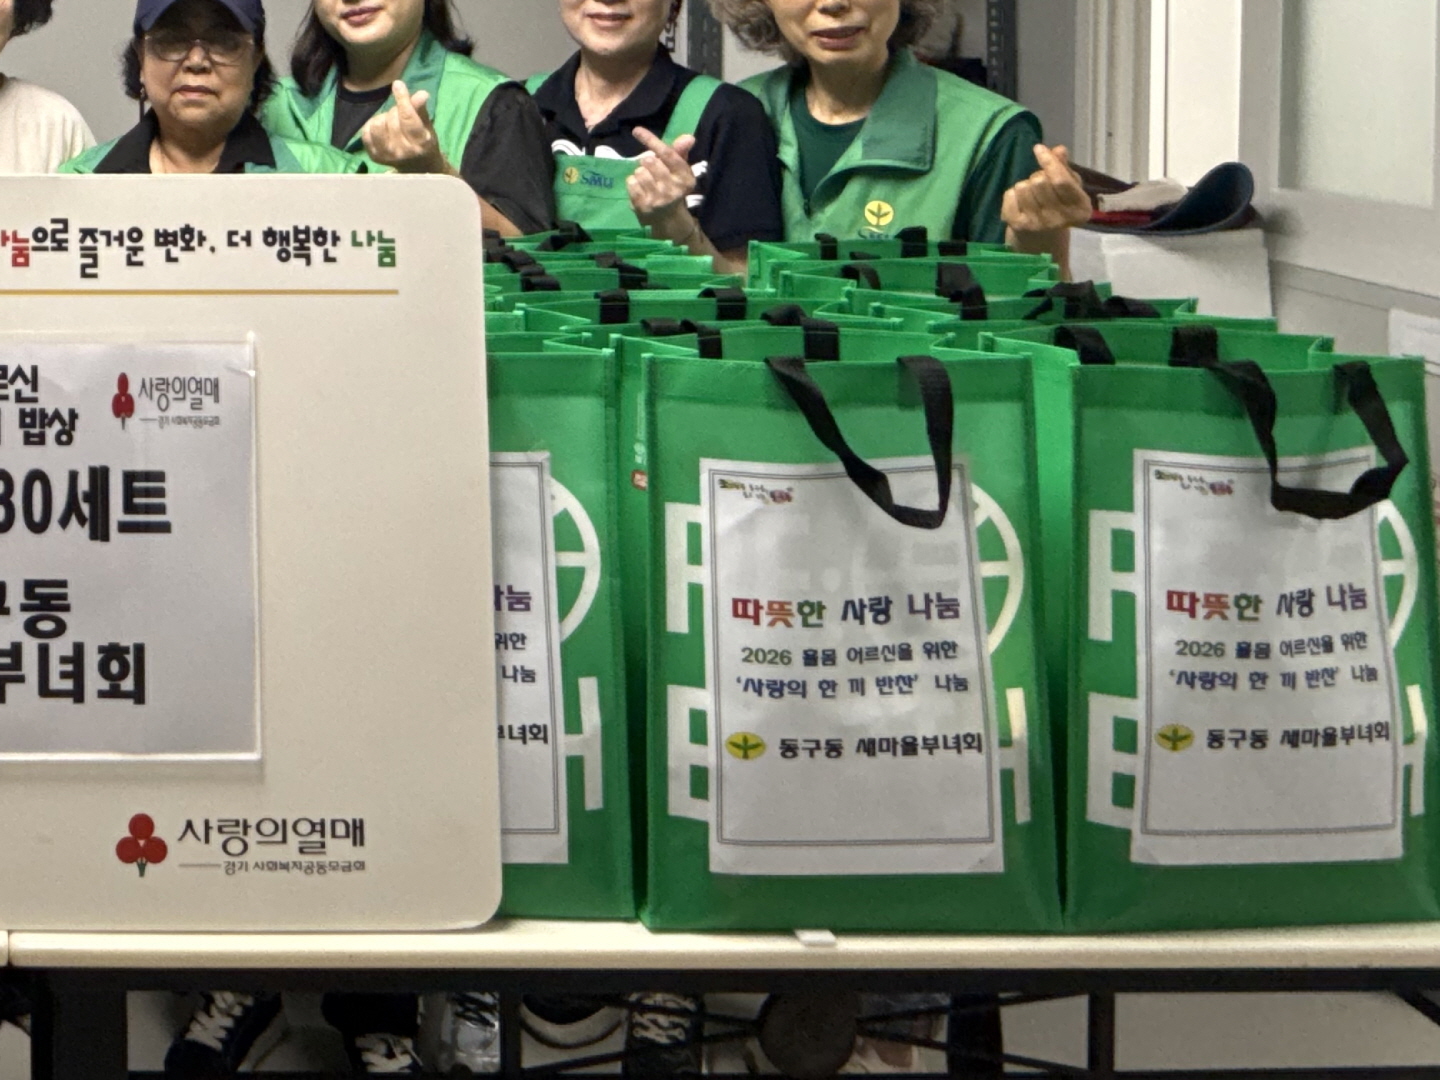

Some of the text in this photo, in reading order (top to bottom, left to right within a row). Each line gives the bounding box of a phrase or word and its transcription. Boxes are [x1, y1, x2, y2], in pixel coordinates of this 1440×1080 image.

[79, 227, 144, 279] 즐거운
[154, 224, 215, 263] 변화,
[227, 230, 251, 247] 더
[262, 225, 341, 266] 행복한
[351, 230, 396, 267] 나눔
[138, 377, 219, 412] 사랑의열매
[19, 408, 79, 446] 밥상
[732, 592, 960, 628] 따뜻한 사랑 나눔
[1167, 583, 1367, 623] 따뜻한 사랑 나눔
[742, 647, 792, 666] 2026
[847, 643, 913, 663] 어르신을
[1176, 640, 1227, 658] 2026
[1280, 635, 1334, 658] 어르신을
[500, 664, 536, 683] 나눔
[935, 674, 969, 692] 나눔
[1352, 665, 1378, 682] 나눔
[779, 733, 982, 759] 동구동 새마을부녀회
[1207, 722, 1389, 750] 동구동 새마을부녀회
[178, 818, 365, 857] 사랑의열매
